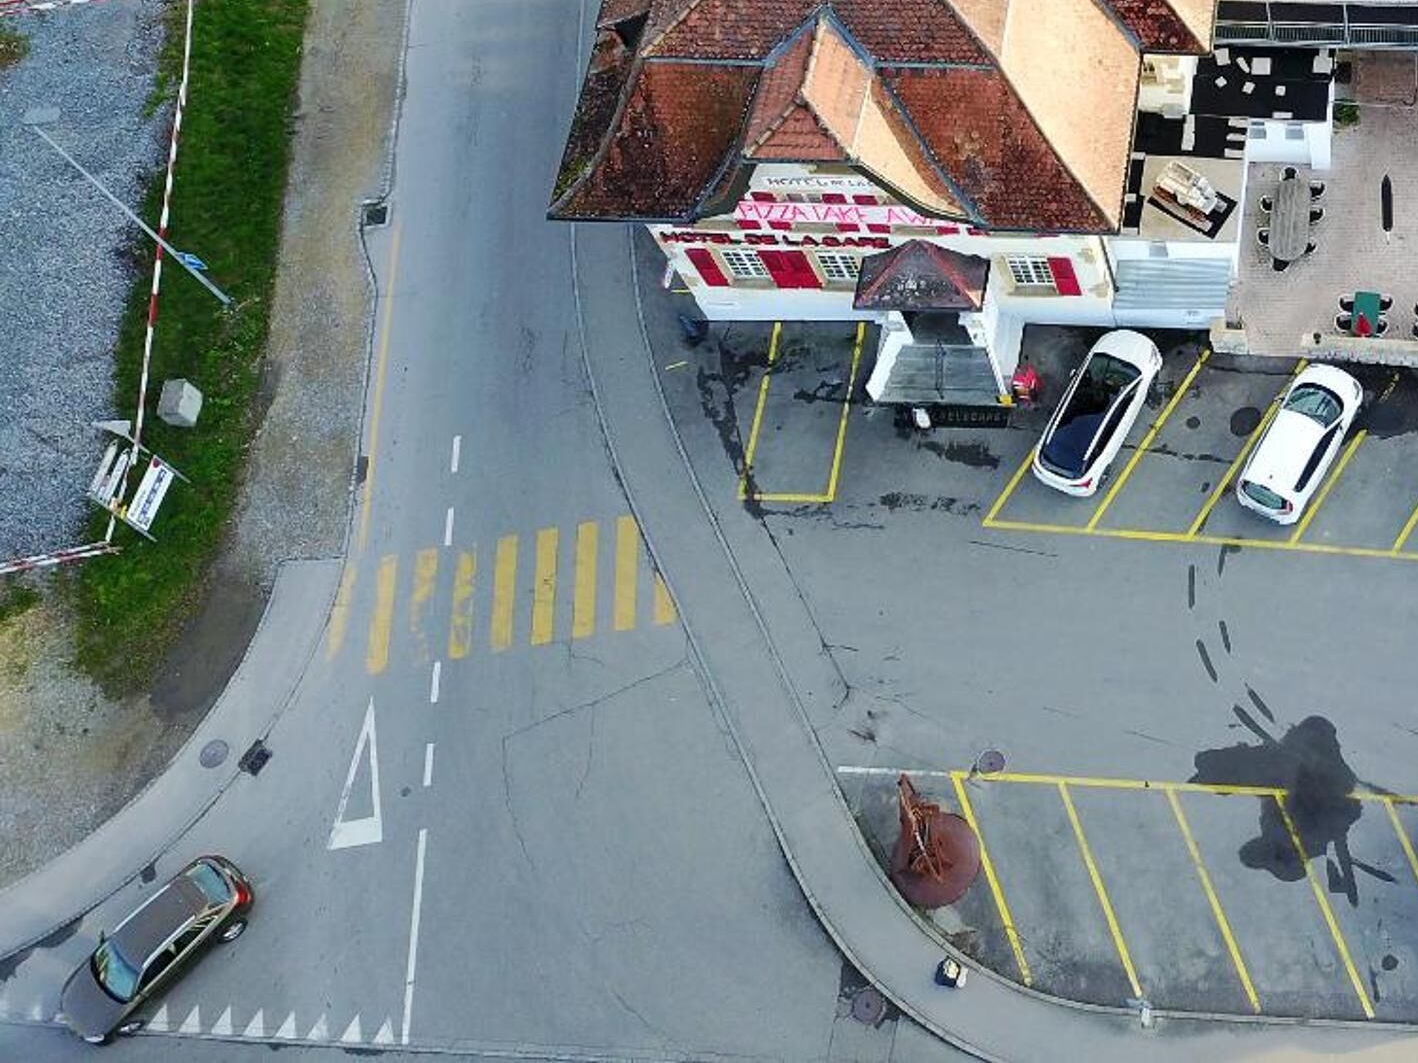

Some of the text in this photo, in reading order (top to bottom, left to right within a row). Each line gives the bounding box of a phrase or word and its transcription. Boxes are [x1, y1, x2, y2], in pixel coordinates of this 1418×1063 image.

[738, 203, 808, 220] PIZZA
[809, 204, 869, 223] TAKE
[660, 231, 893, 248] HOTEL DE LA GARE
